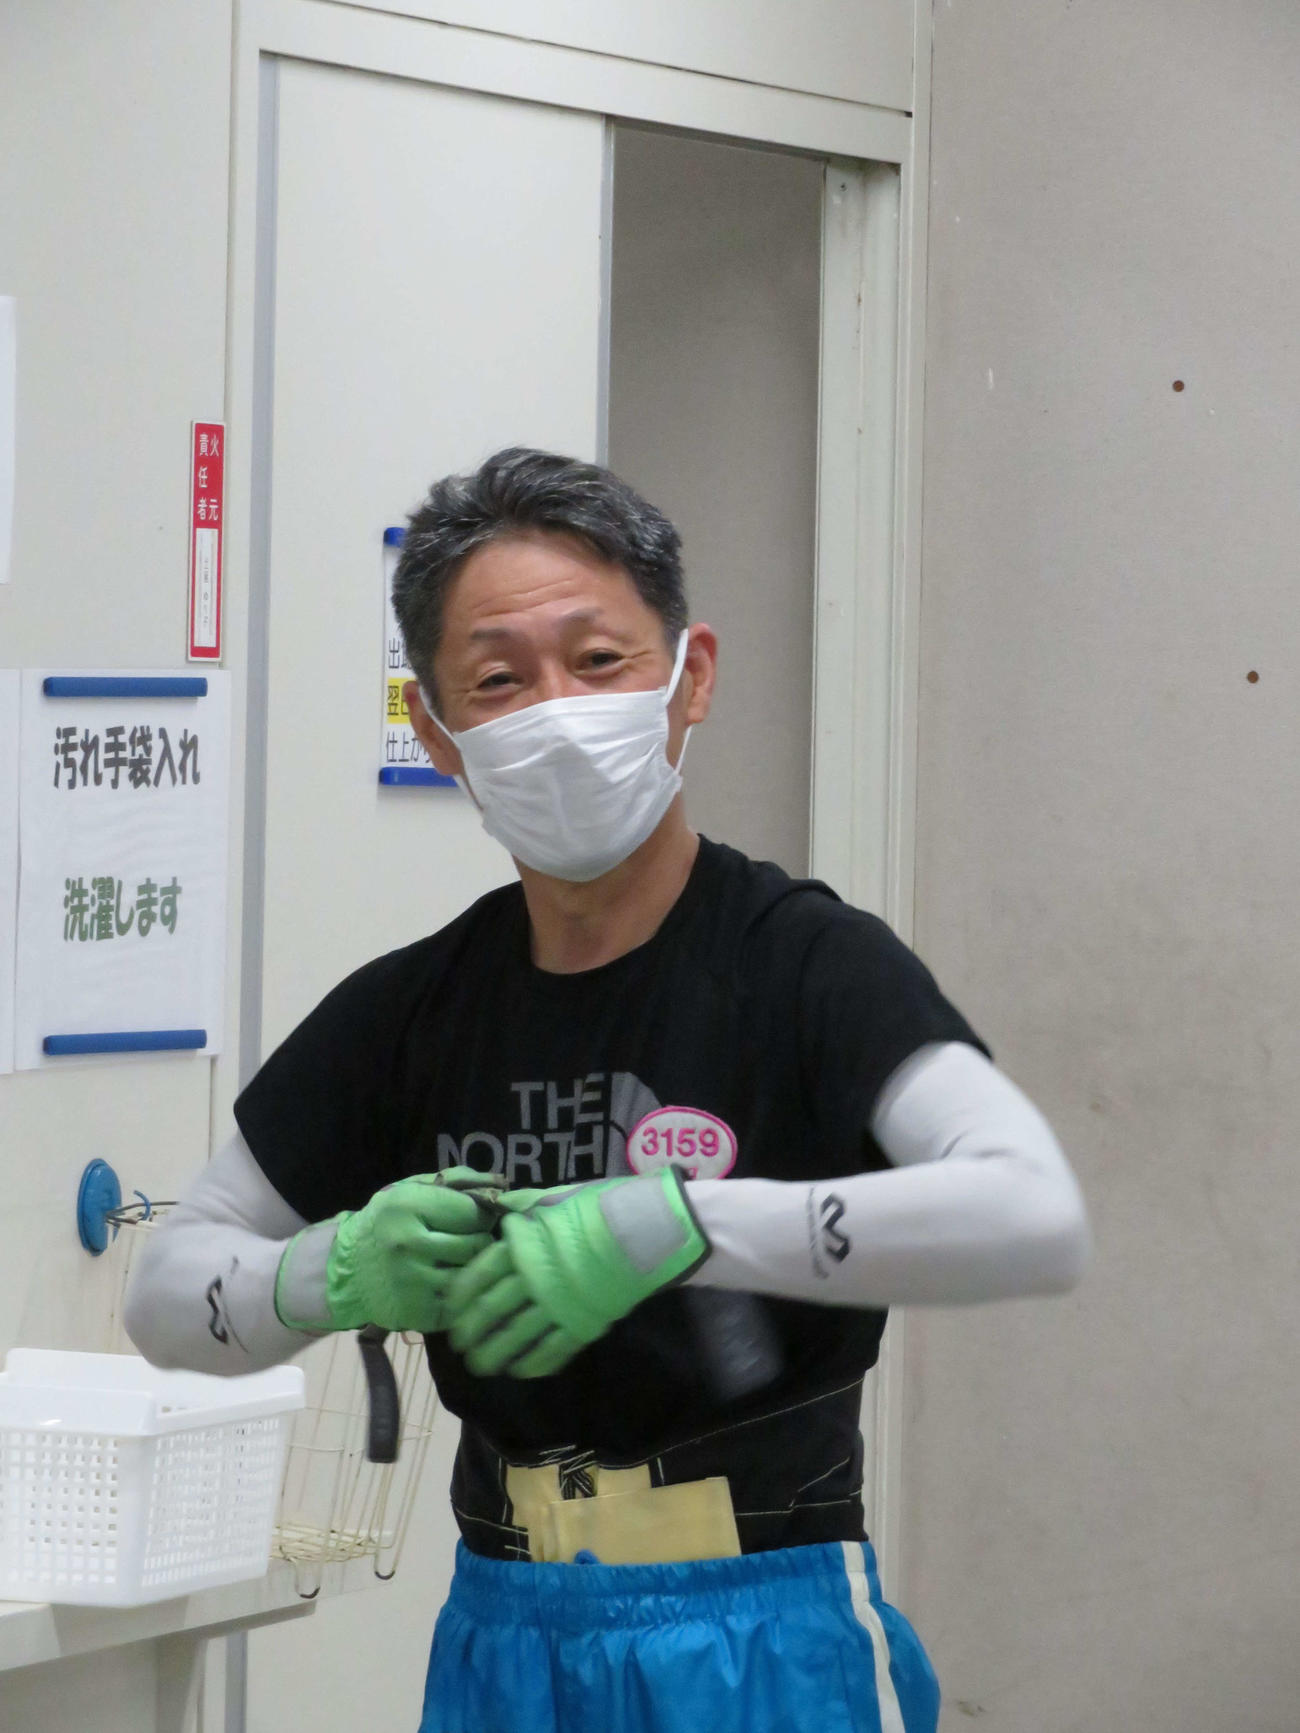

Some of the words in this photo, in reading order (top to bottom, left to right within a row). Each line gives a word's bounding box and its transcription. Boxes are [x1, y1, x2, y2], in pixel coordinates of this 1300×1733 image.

[197, 433, 209, 520] 責任者
[209, 434, 219, 521] 火元
[53, 725, 201, 790] 汚れ手袋入れ
[63, 876, 182, 942] 洗濯します
[511, 1072, 604, 1130] THE
[437, 1126, 604, 1183] NORTH
[641, 1126, 720, 1158] 3159
